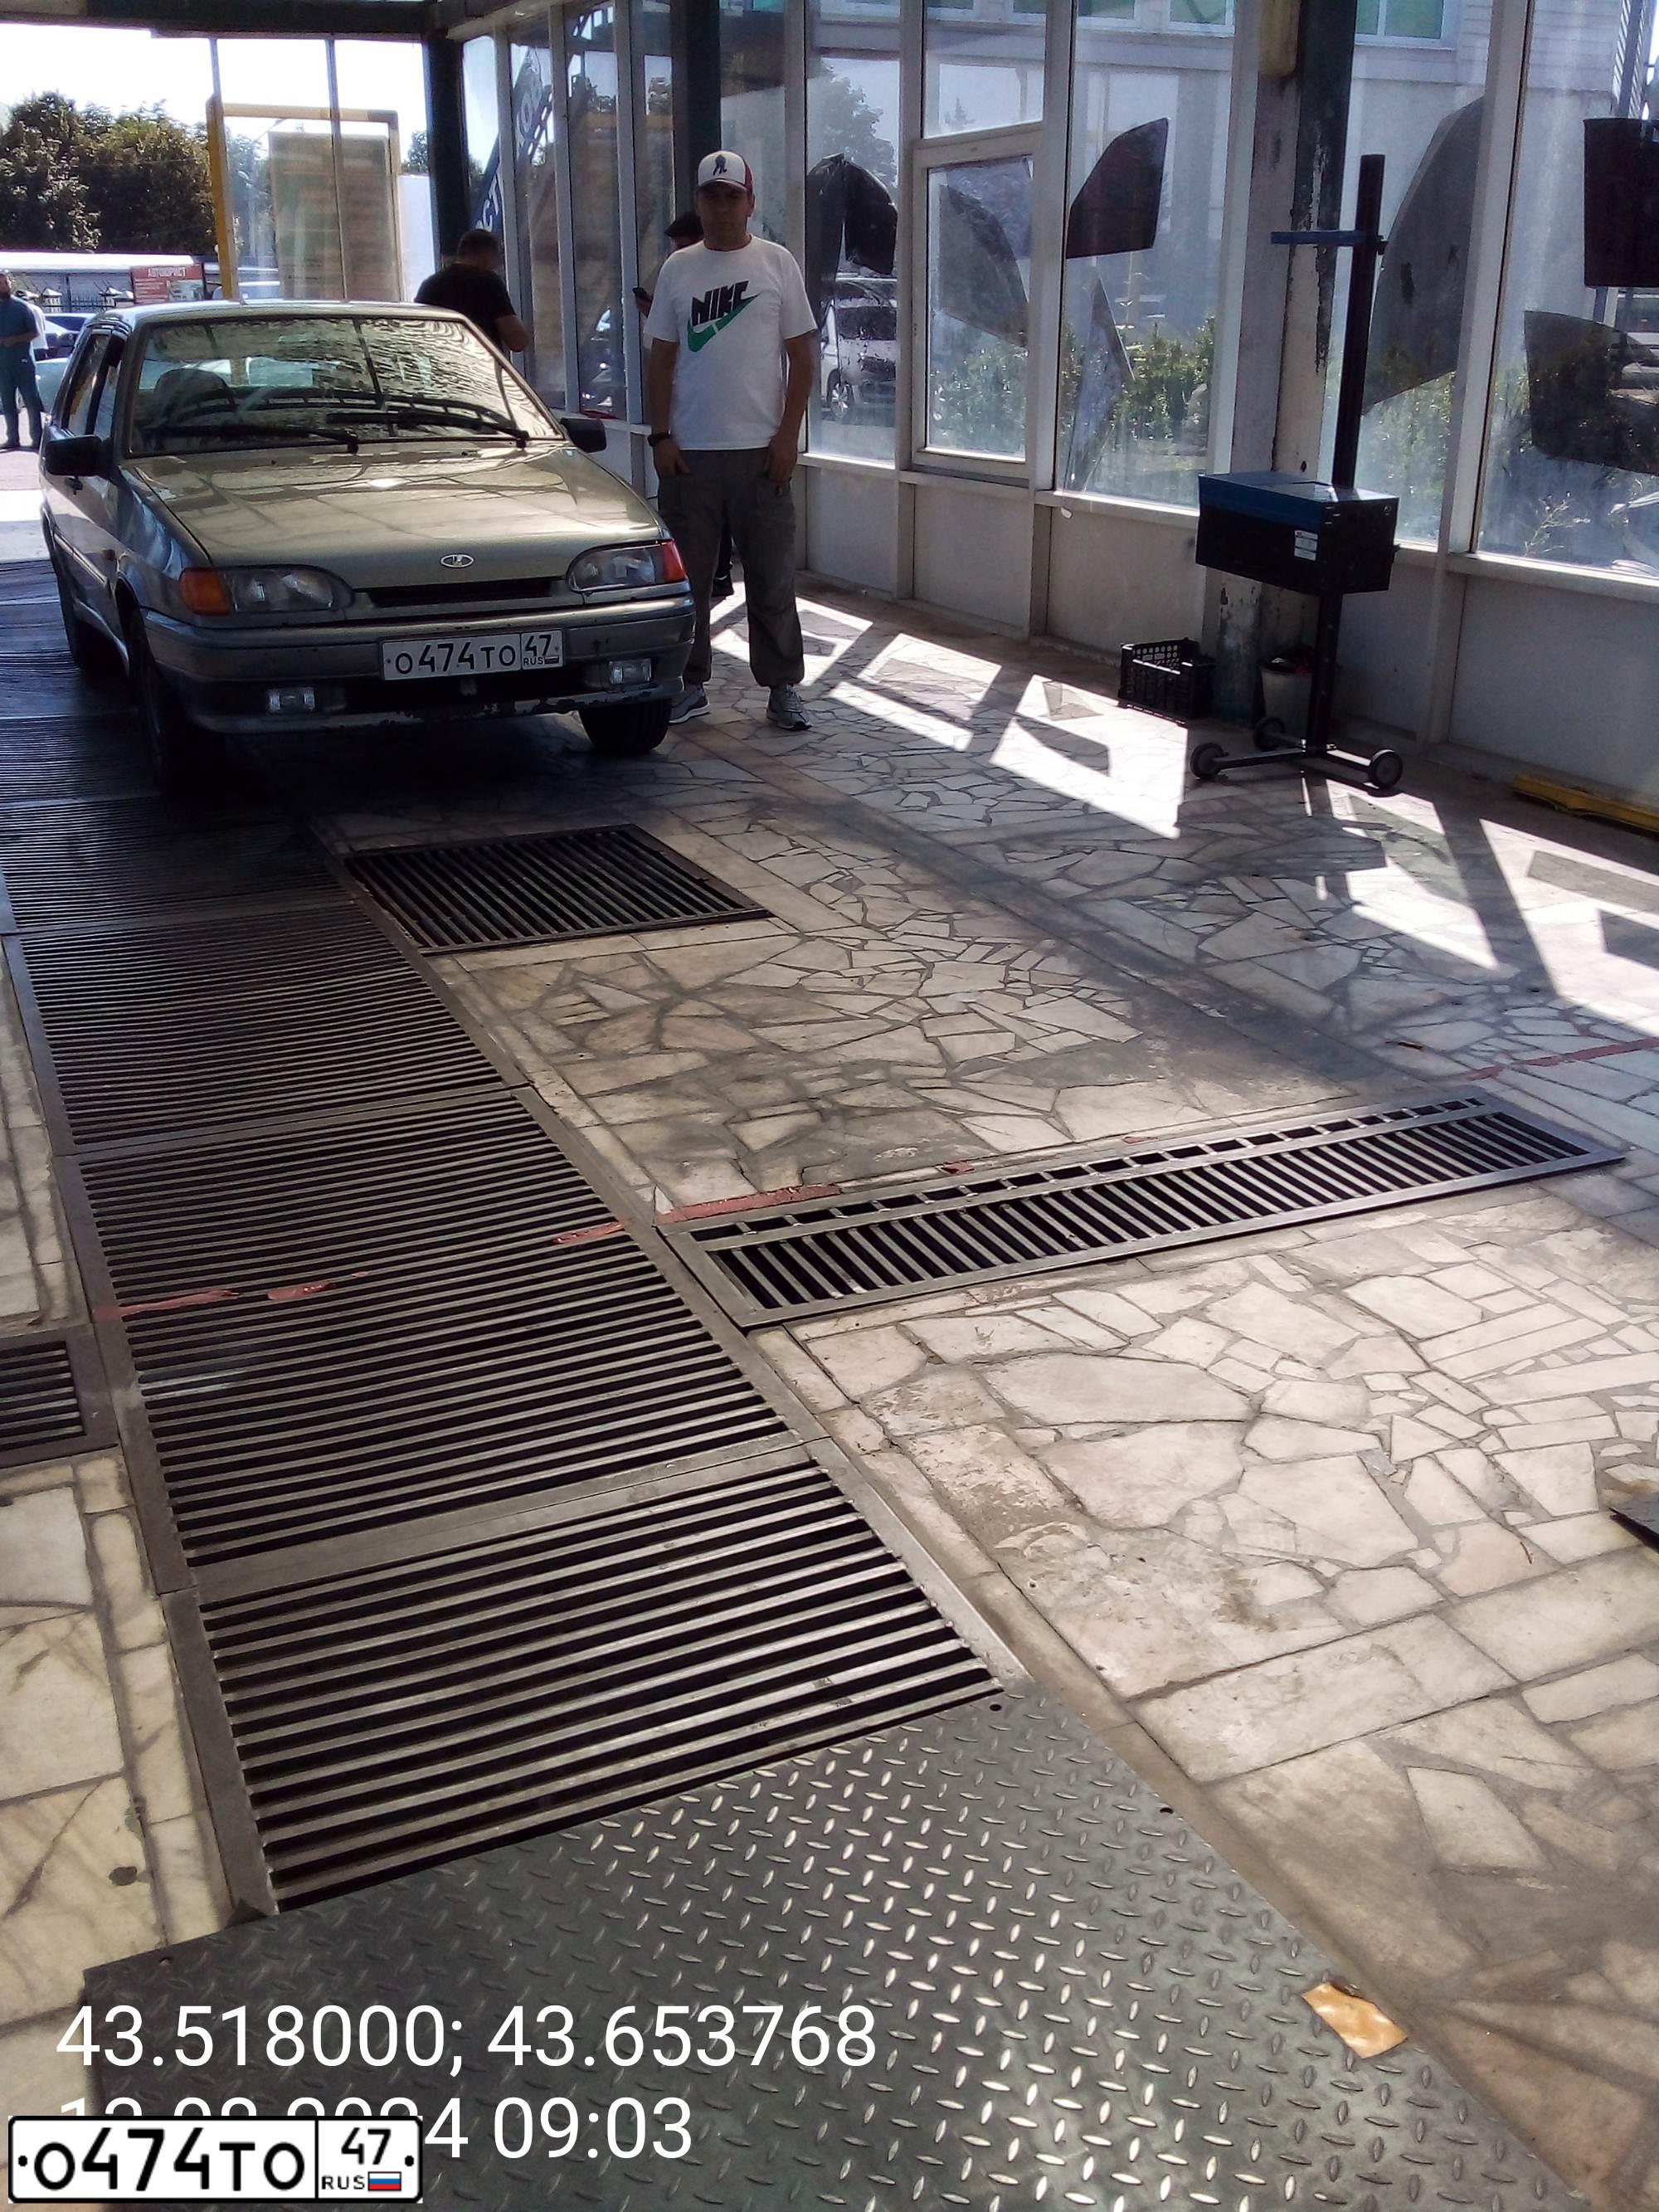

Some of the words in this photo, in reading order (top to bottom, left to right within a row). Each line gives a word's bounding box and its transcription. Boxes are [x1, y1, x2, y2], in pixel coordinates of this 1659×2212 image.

[691, 280, 758, 327] NIKE
[524, 634, 552, 656] 47
[523, 656, 544, 666] RUS
